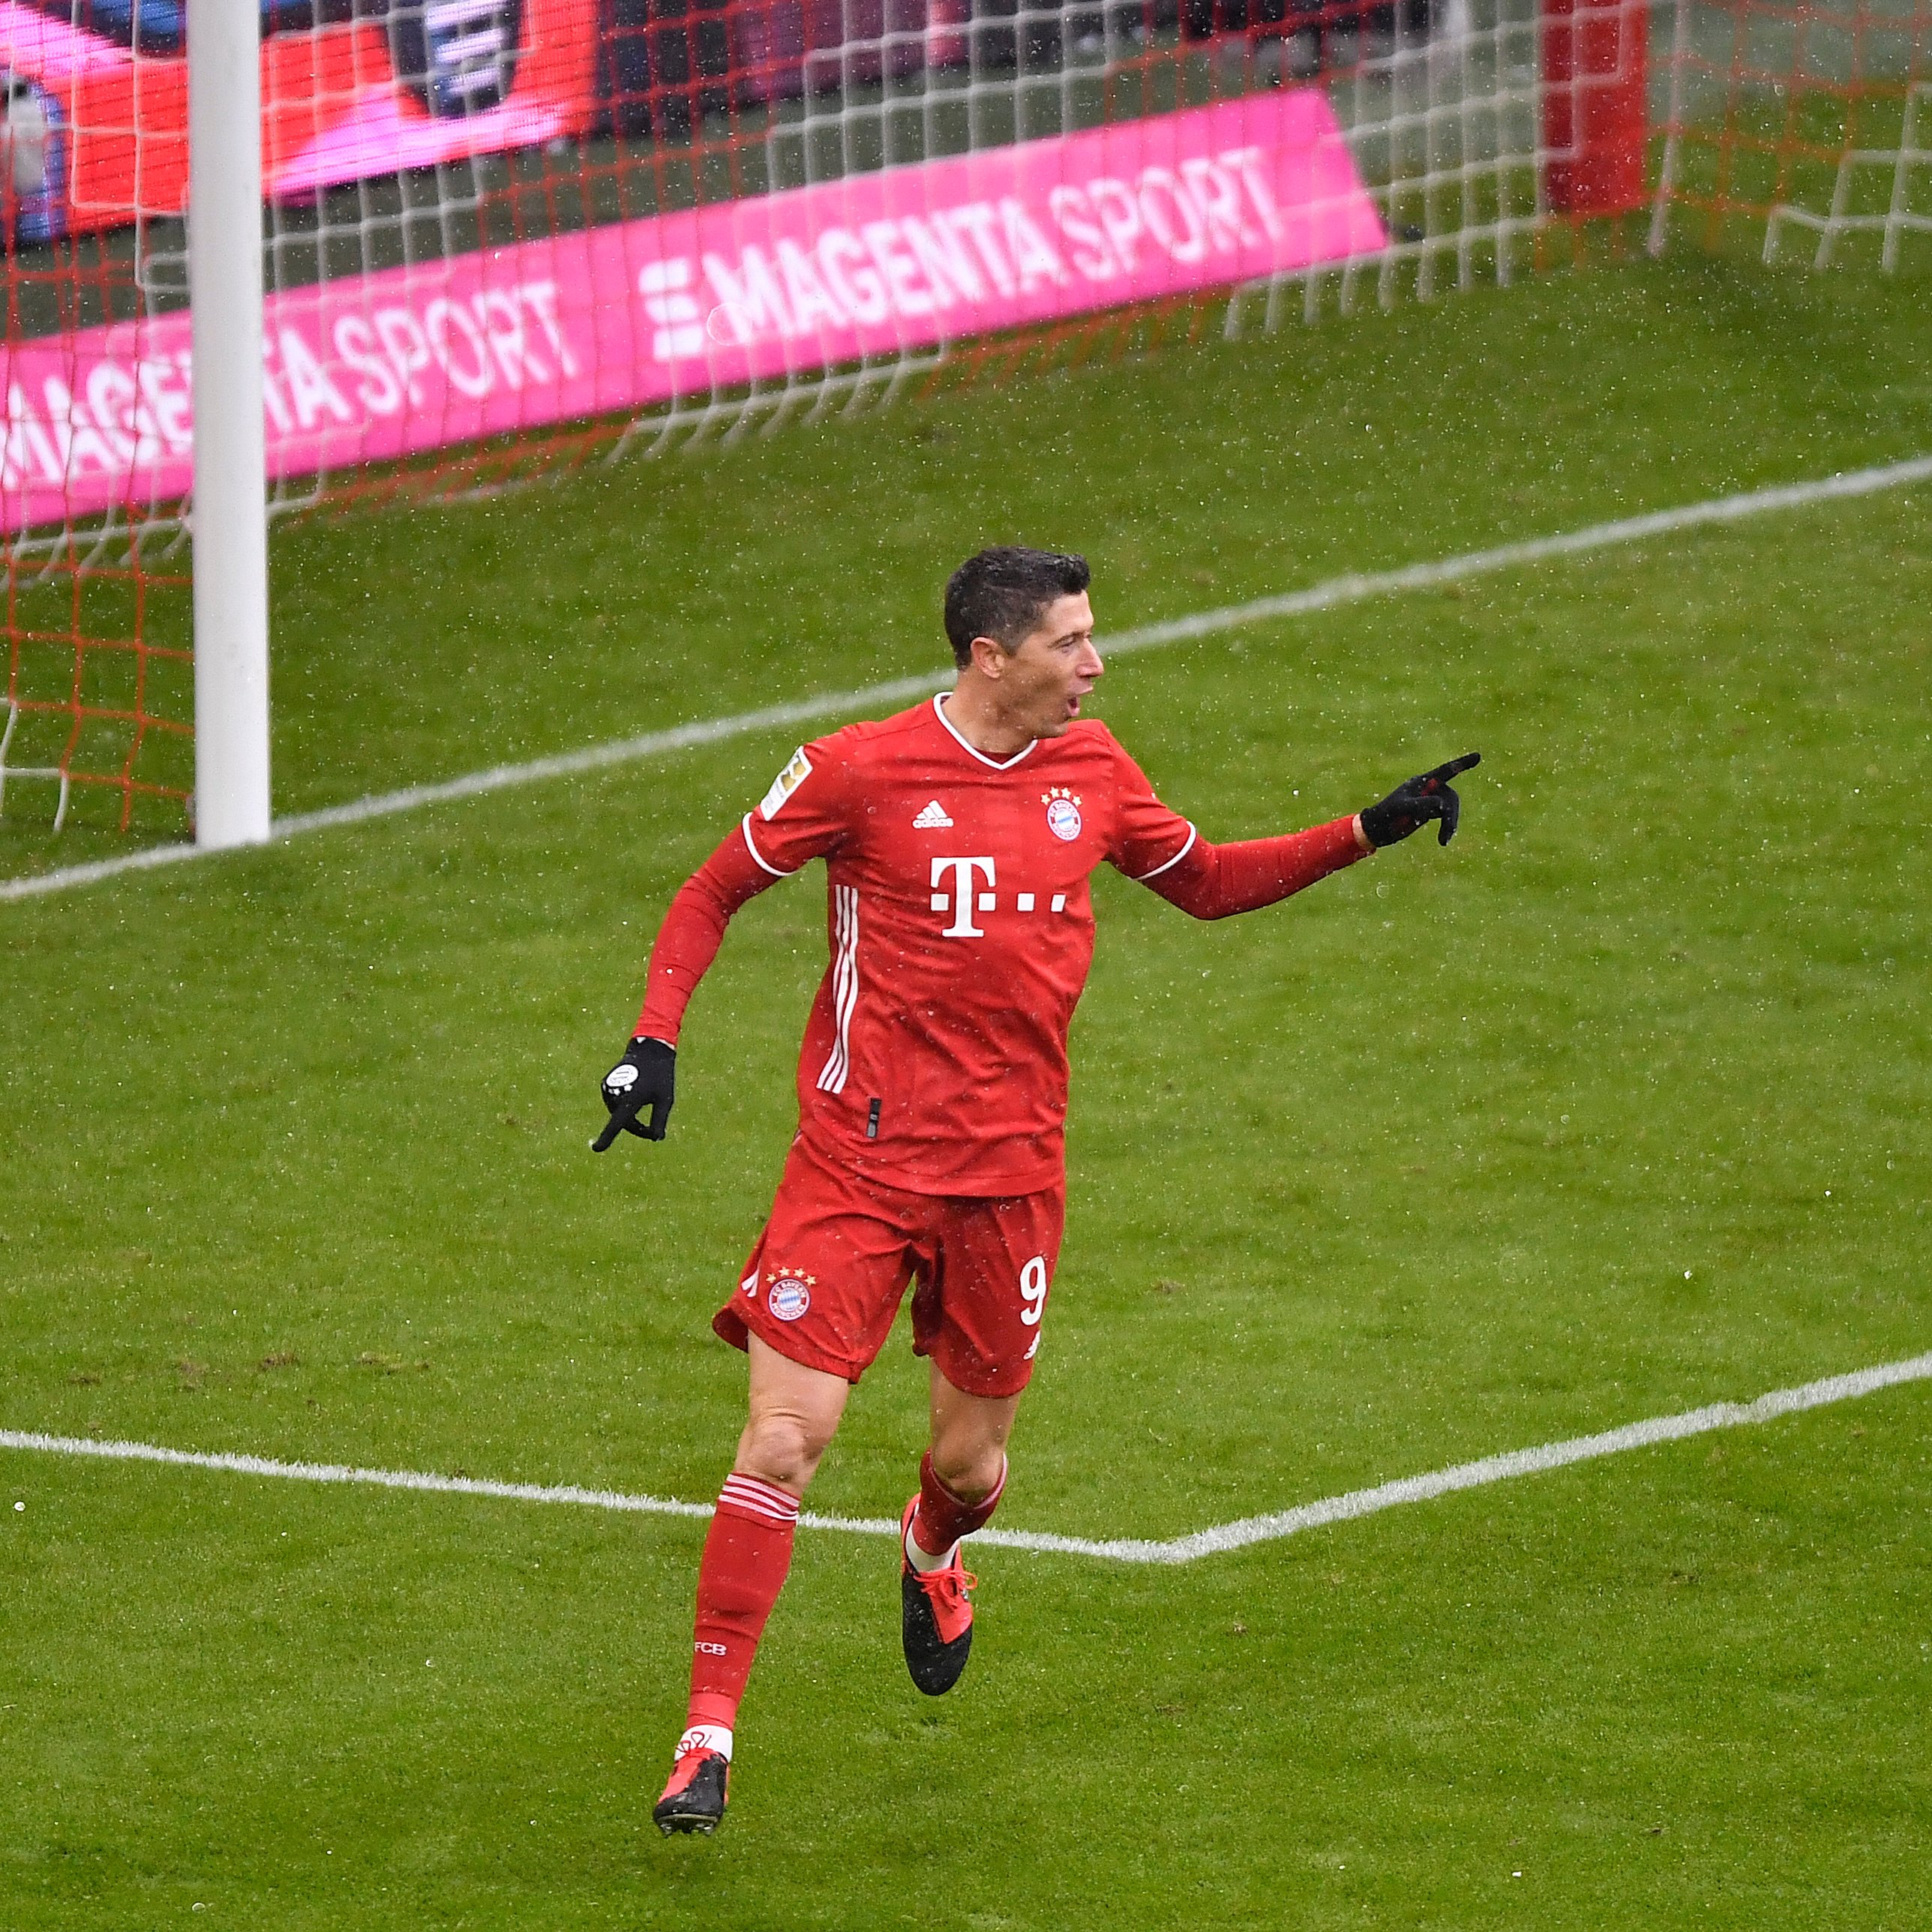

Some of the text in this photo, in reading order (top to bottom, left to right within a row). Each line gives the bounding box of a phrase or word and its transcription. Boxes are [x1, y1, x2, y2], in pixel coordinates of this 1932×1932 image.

[701, 146, 1284, 344] MAGENTA SPORT
[0, 280, 577, 490] MAGEA SPORT
[1020, 1256, 1047, 1326] 9
[694, 1641, 727, 1656] FCB
